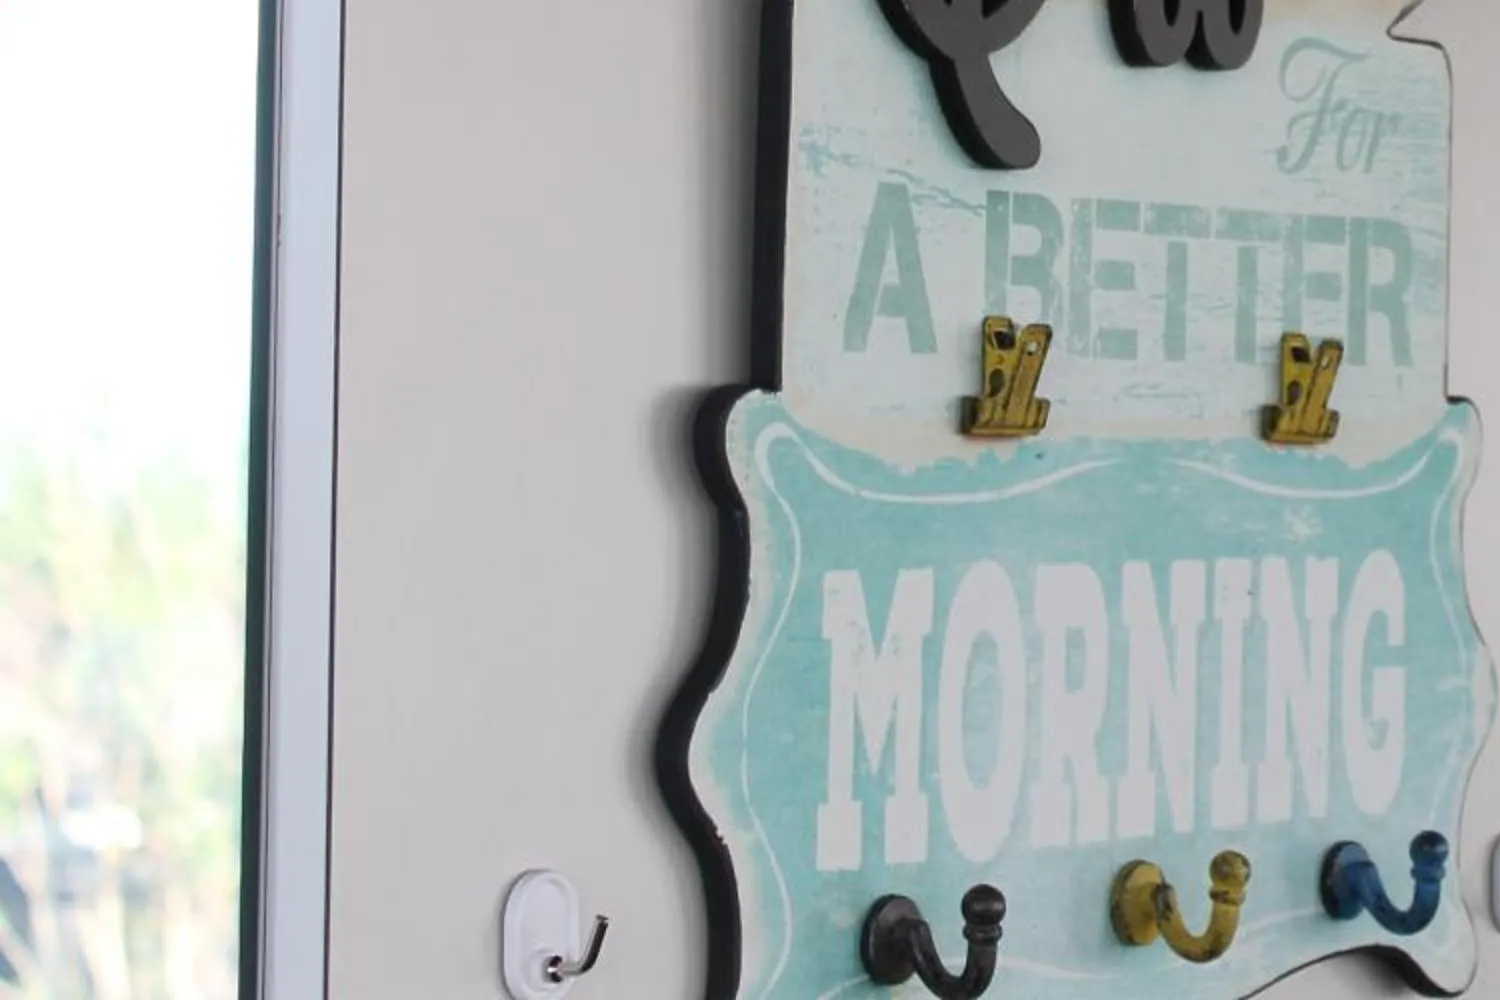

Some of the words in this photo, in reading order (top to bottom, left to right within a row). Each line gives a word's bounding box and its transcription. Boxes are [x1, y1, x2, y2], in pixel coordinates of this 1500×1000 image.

[1276, 36, 1399, 174] For
[842, 182, 939, 355] A
[983, 189, 1415, 367] BETTER
[815, 549, 1406, 871] MORNING
